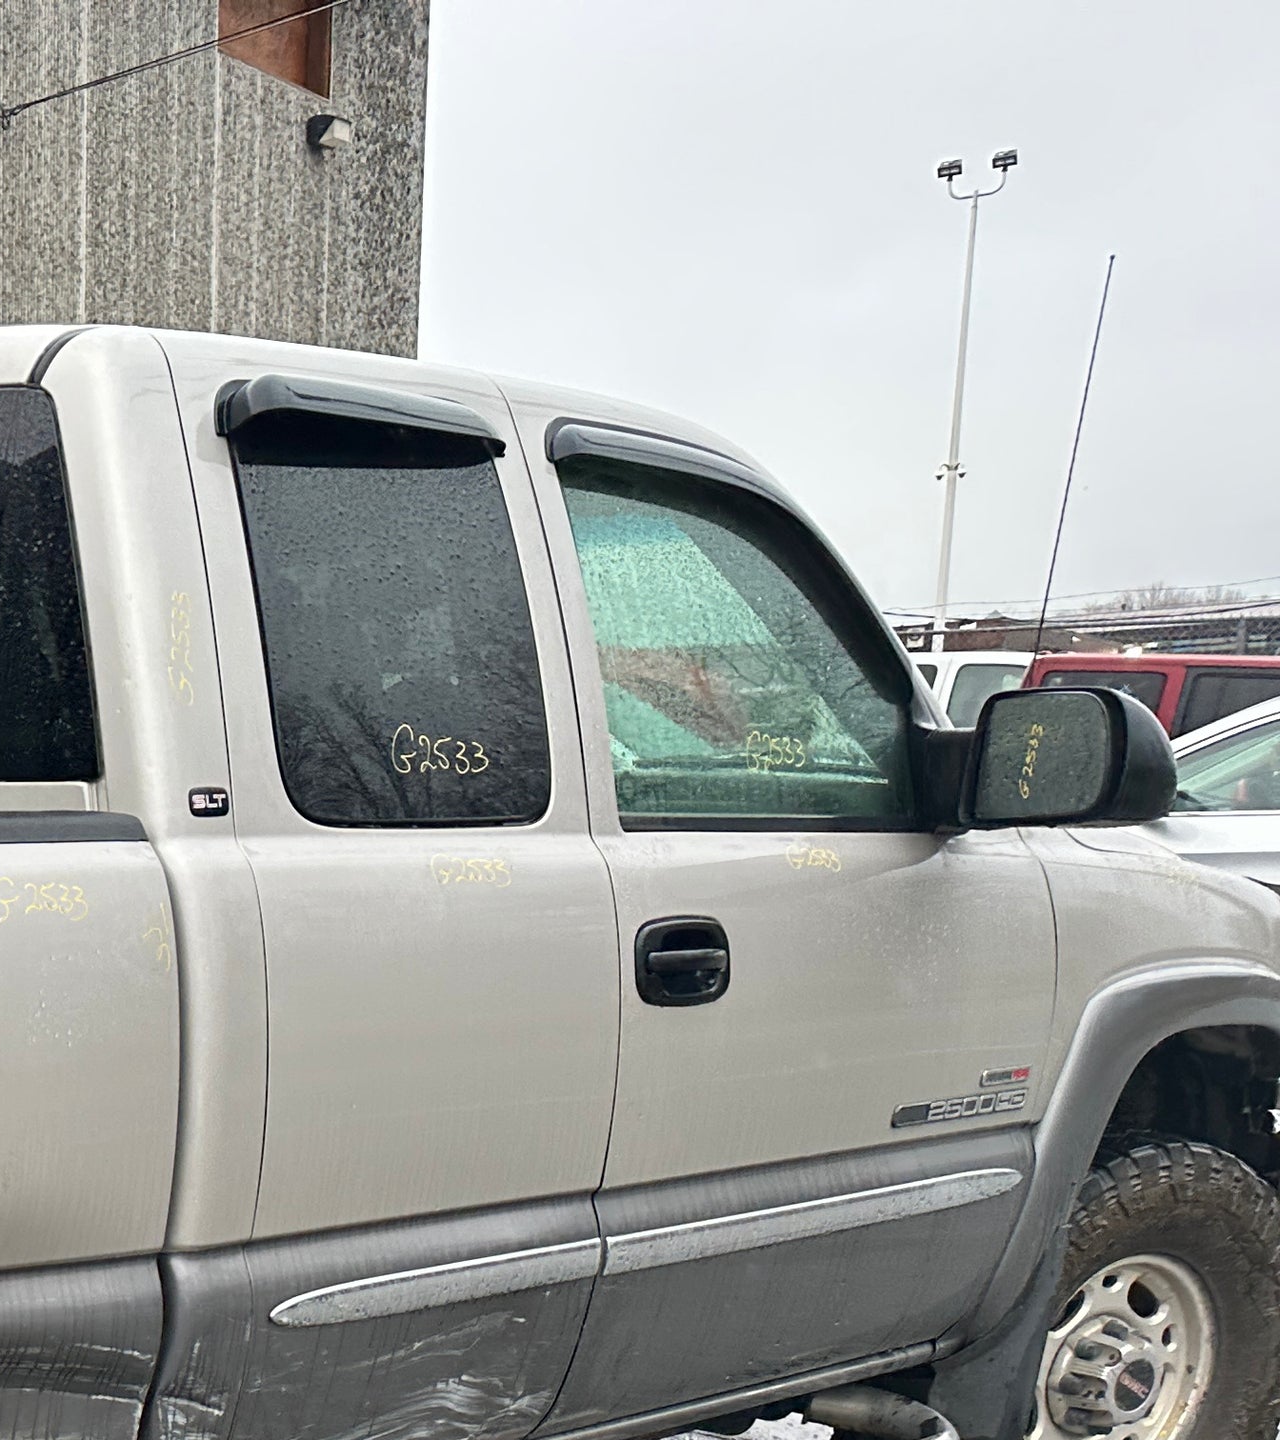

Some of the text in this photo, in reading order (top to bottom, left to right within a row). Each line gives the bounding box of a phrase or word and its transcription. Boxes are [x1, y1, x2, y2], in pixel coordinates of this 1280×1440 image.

[392, 724, 490, 775] G2533
[746, 730, 806, 774] G2533
[1018, 723, 1043, 799] G2533
[191, 793, 226, 810] SLT
[430, 853, 512, 888] G2533
